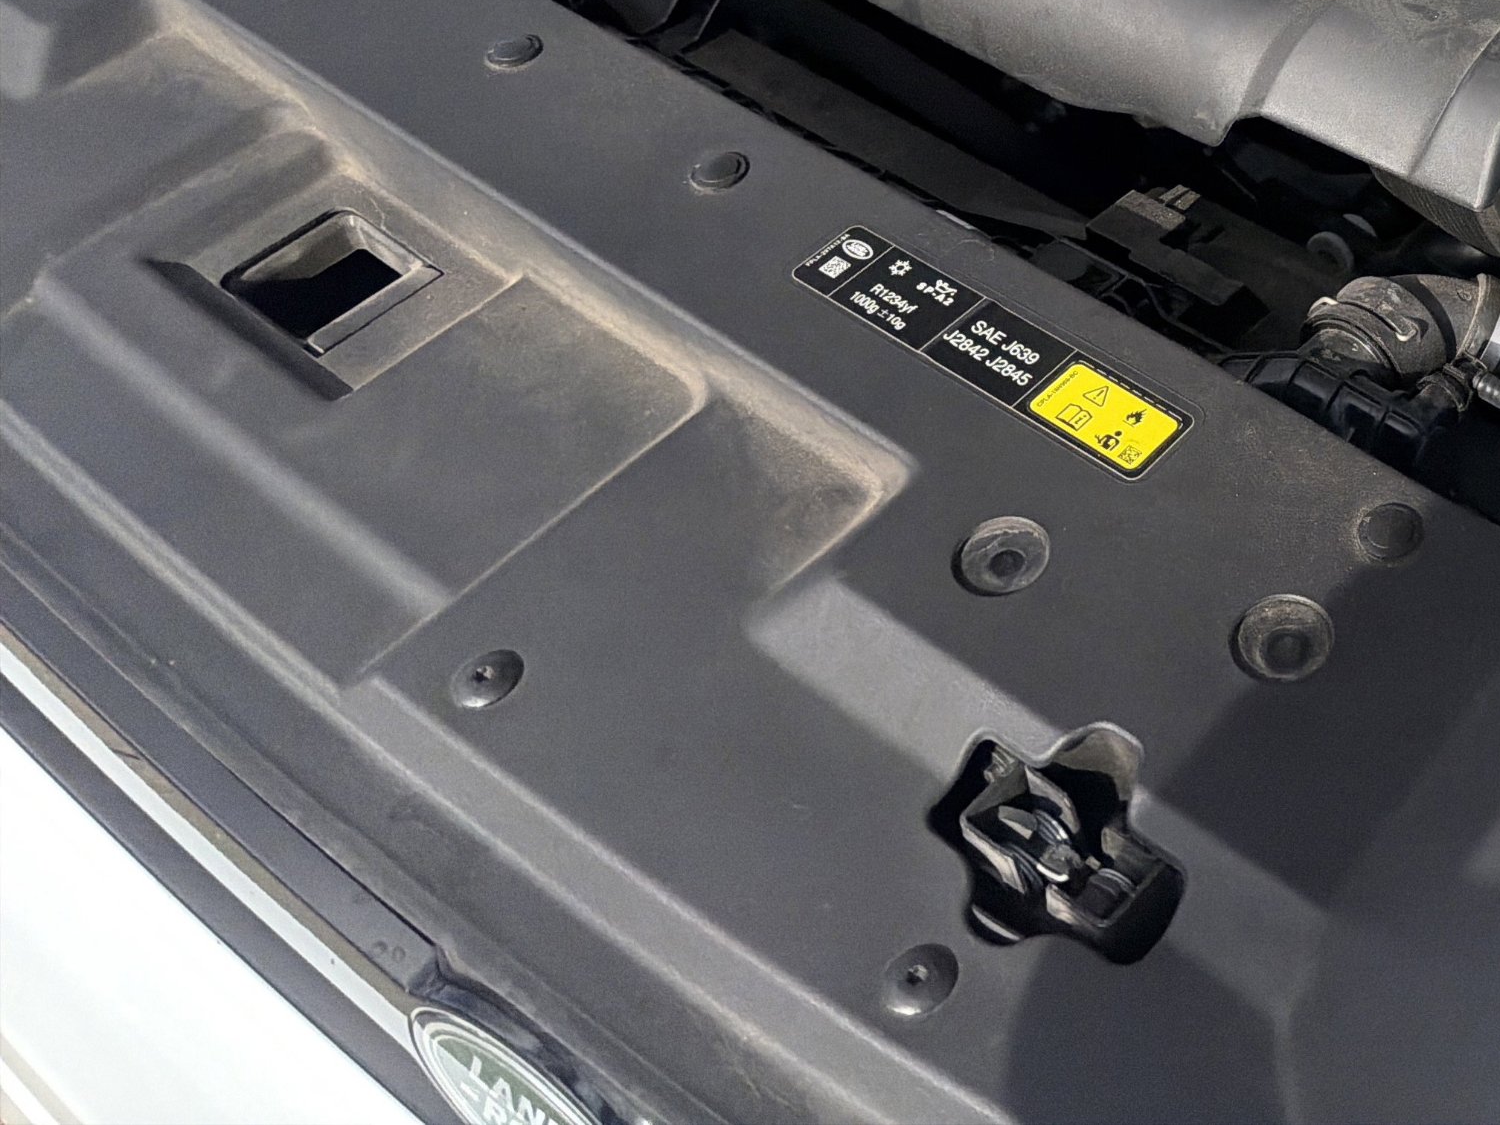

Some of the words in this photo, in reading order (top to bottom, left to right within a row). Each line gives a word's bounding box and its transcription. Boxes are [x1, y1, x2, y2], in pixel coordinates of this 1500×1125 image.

[849, 291, 880, 315] 1000g
[869, 283, 919, 314] R1234yf
[942, 329, 990, 362] J2842
[985, 356, 1034, 386] J2845
[970, 320, 1007, 345] SAE
[1001, 340, 1040, 365] J639
[469, 1055, 560, 1125] LAN
